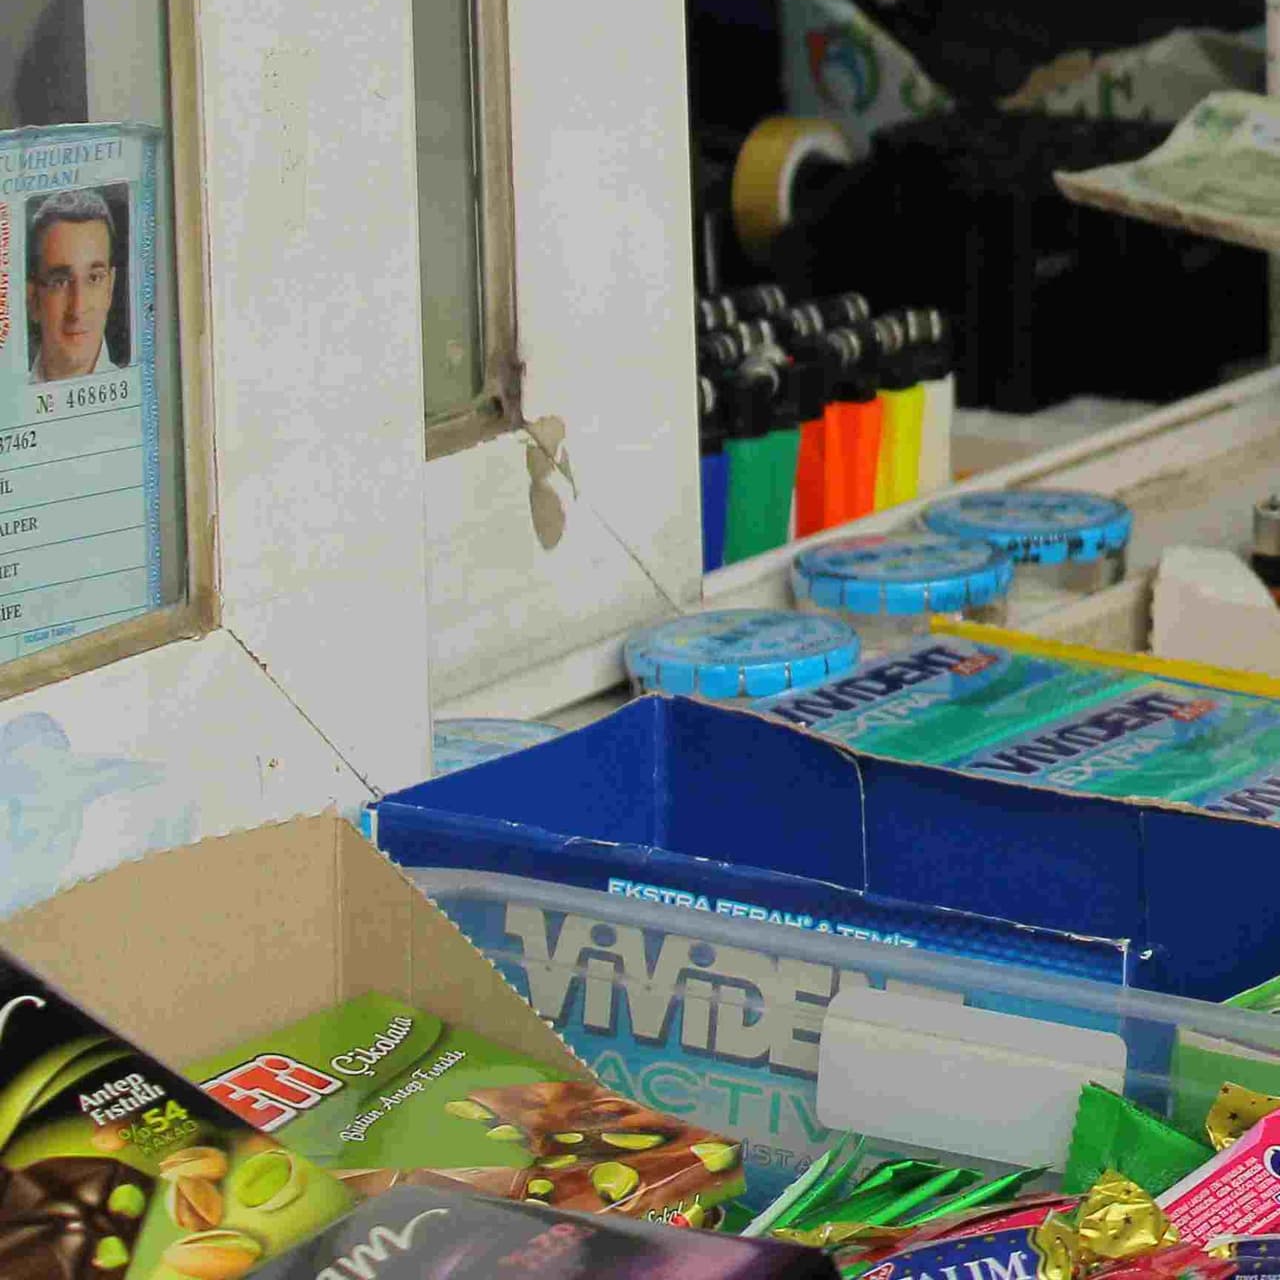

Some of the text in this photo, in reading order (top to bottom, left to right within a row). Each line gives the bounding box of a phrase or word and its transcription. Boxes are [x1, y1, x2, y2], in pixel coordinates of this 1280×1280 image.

[66, 380, 128, 409] 468683
[608, 877, 711, 912] EKSTRA
[330, 1016, 413, 1077] Çikolata
[79, 1072, 146, 1112] Antep
[384, 1077, 428, 1111] Antep
